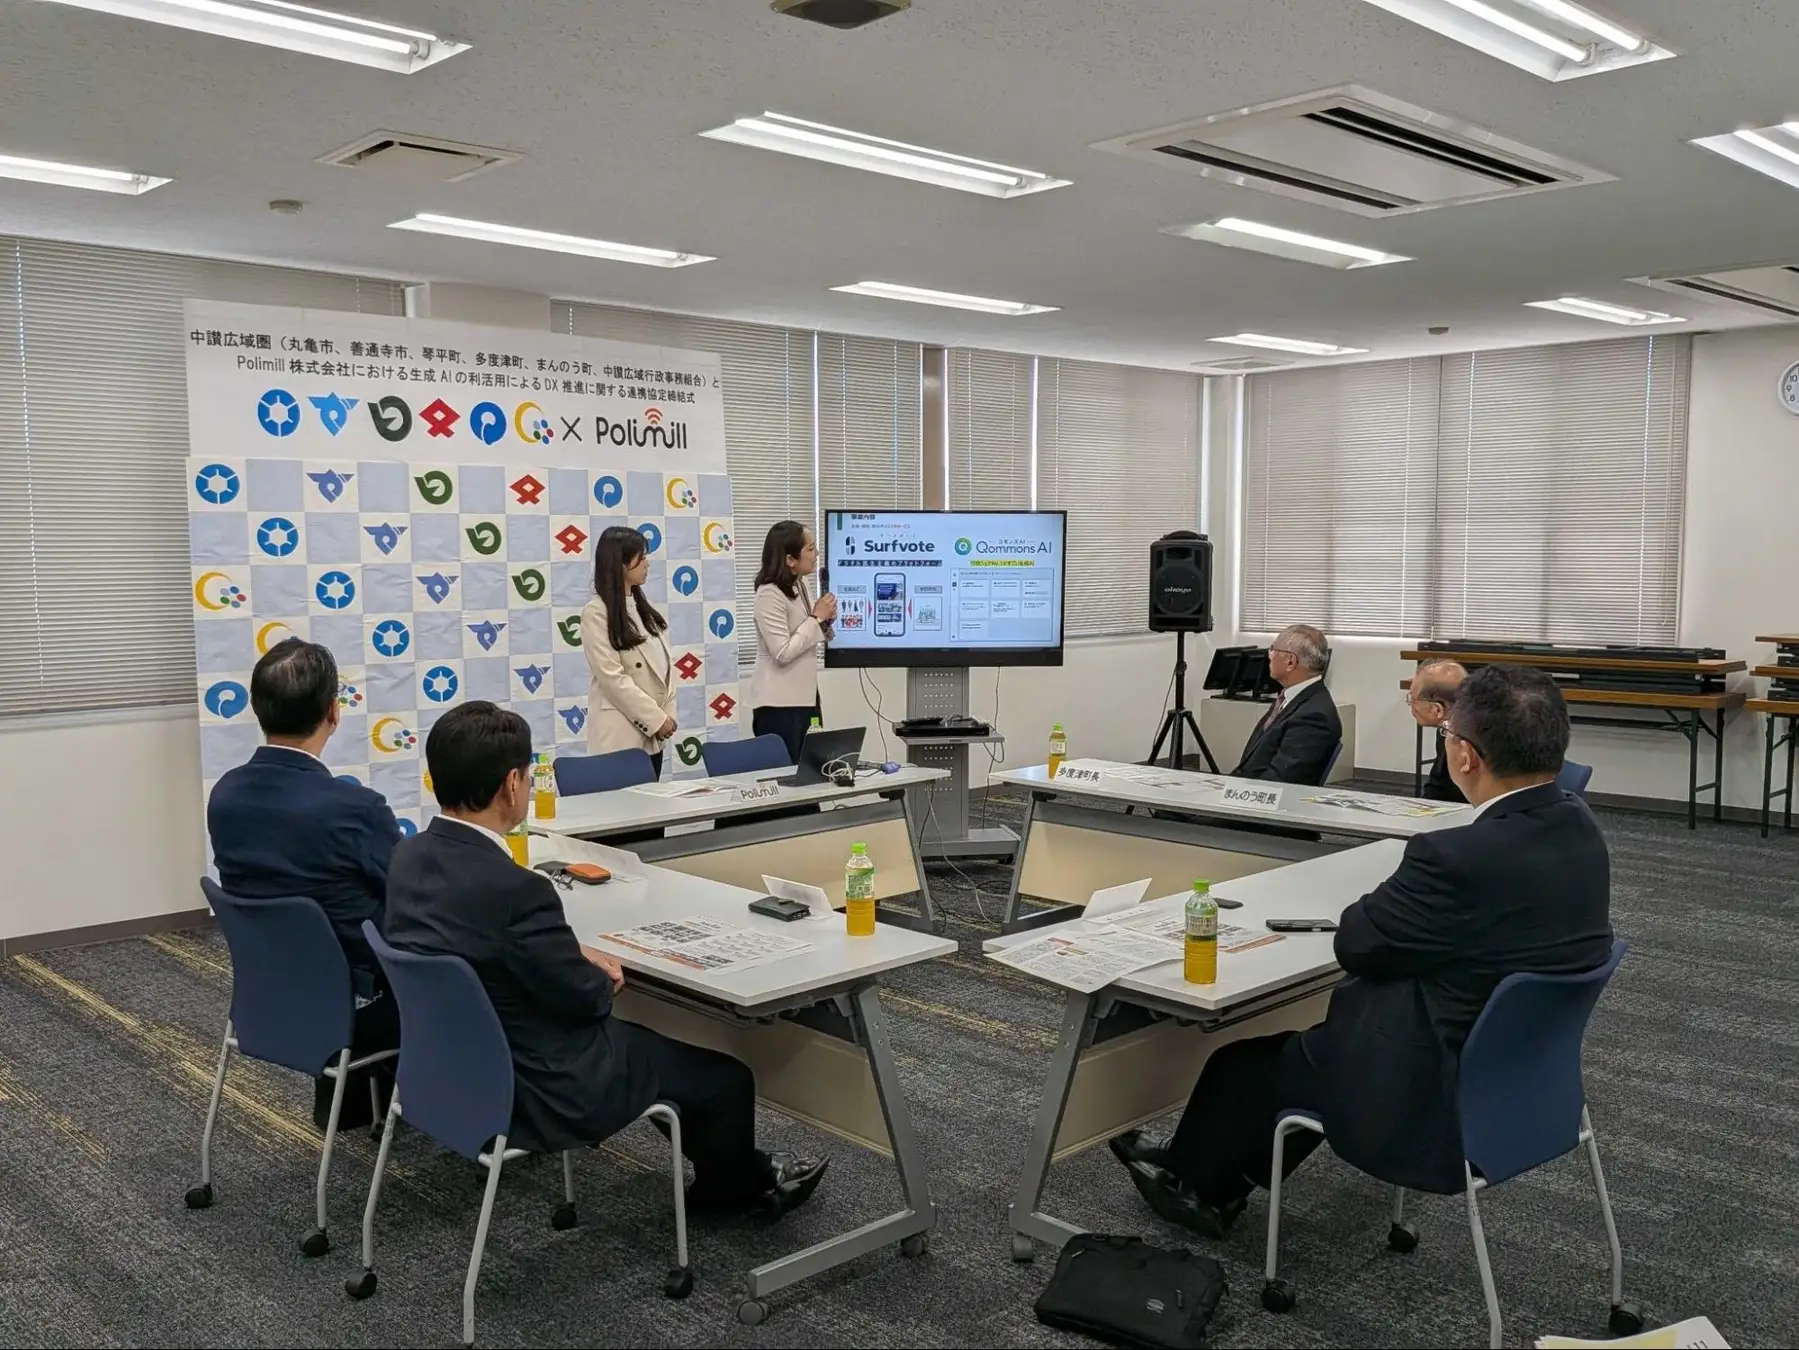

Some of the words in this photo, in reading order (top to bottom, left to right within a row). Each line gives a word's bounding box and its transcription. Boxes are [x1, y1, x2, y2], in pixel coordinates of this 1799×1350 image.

[237, 355, 285, 372] Polimill
[290, 358, 436, 383] 株式会社における生成
[441, 371, 451, 383] AI
[456, 372, 541, 391] の利活用による
[545, 378, 559, 392] DX
[562, 380, 696, 404] 推進に関する連携協定締結式
[596, 416, 687, 449] Polimill
[864, 539, 935, 553] Surfvote
[976, 540, 1035, 554] Qommons
[1037, 541, 1052, 554] AI
[1058, 766, 1100, 783] 多度津町長
[740, 785, 780, 800] Polimill
[1224, 788, 1277, 805] まんのう町長
